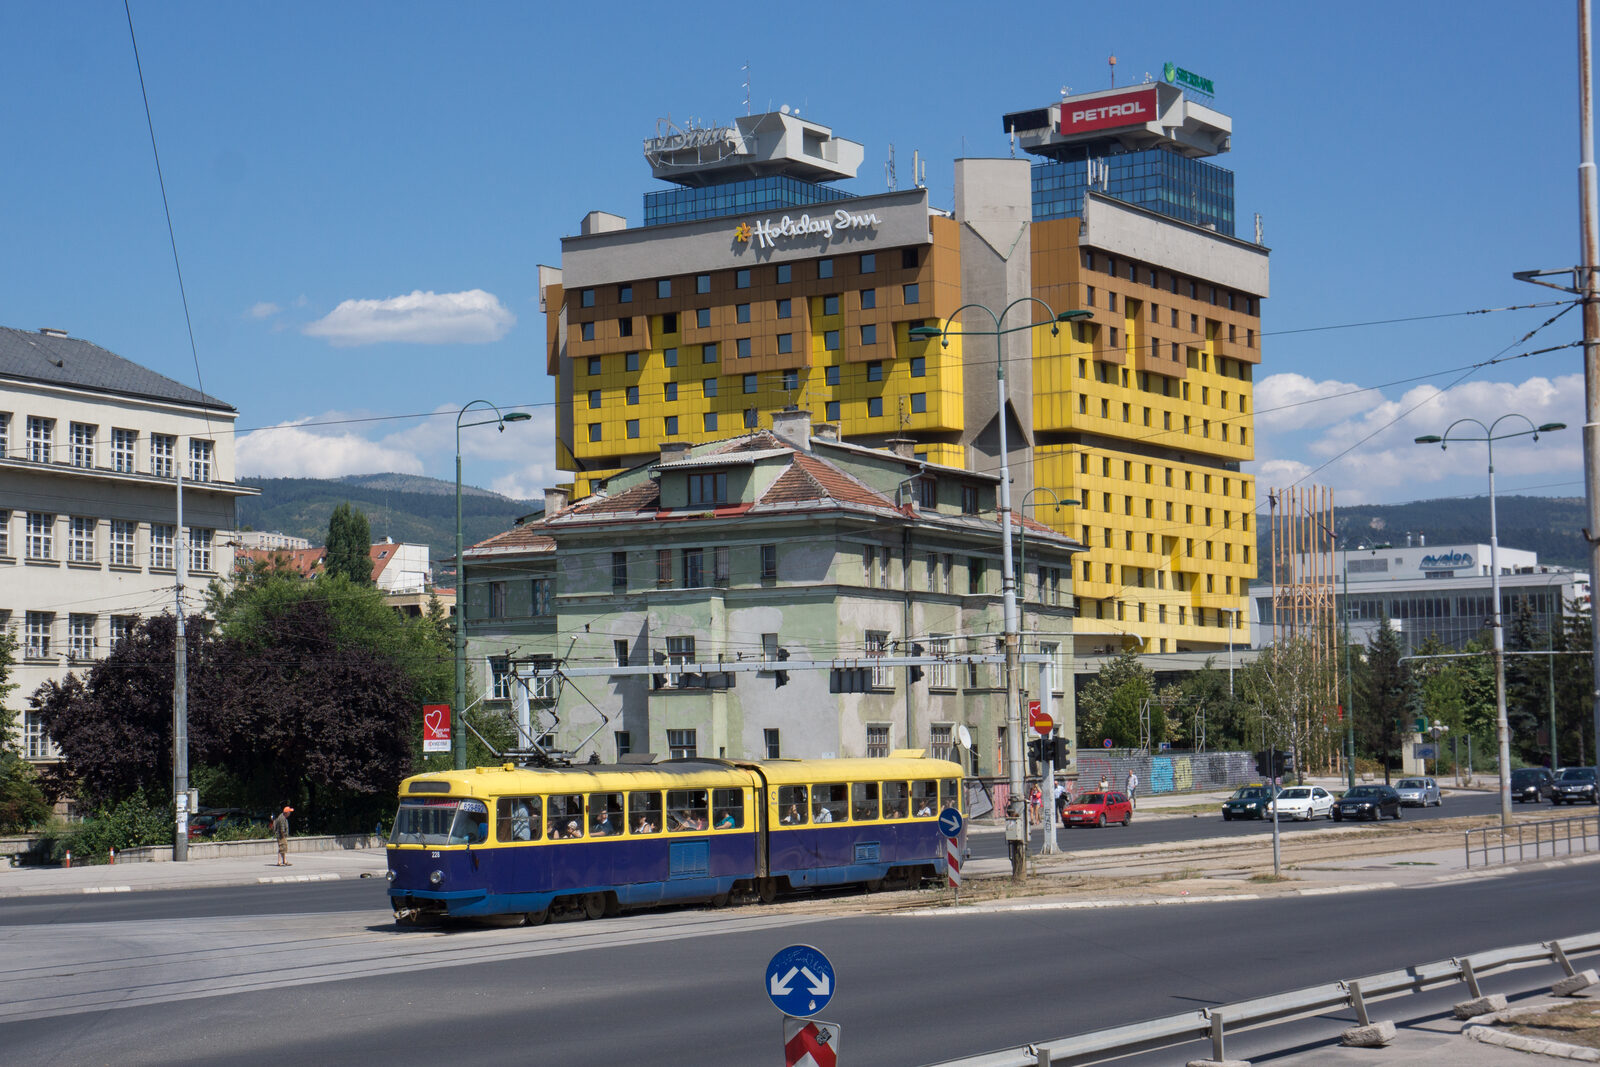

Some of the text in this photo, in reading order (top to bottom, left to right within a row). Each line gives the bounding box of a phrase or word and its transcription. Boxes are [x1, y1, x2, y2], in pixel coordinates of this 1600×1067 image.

[1072, 101, 1146, 124] PETROL
[754, 209, 882, 248] Holiday Inn
